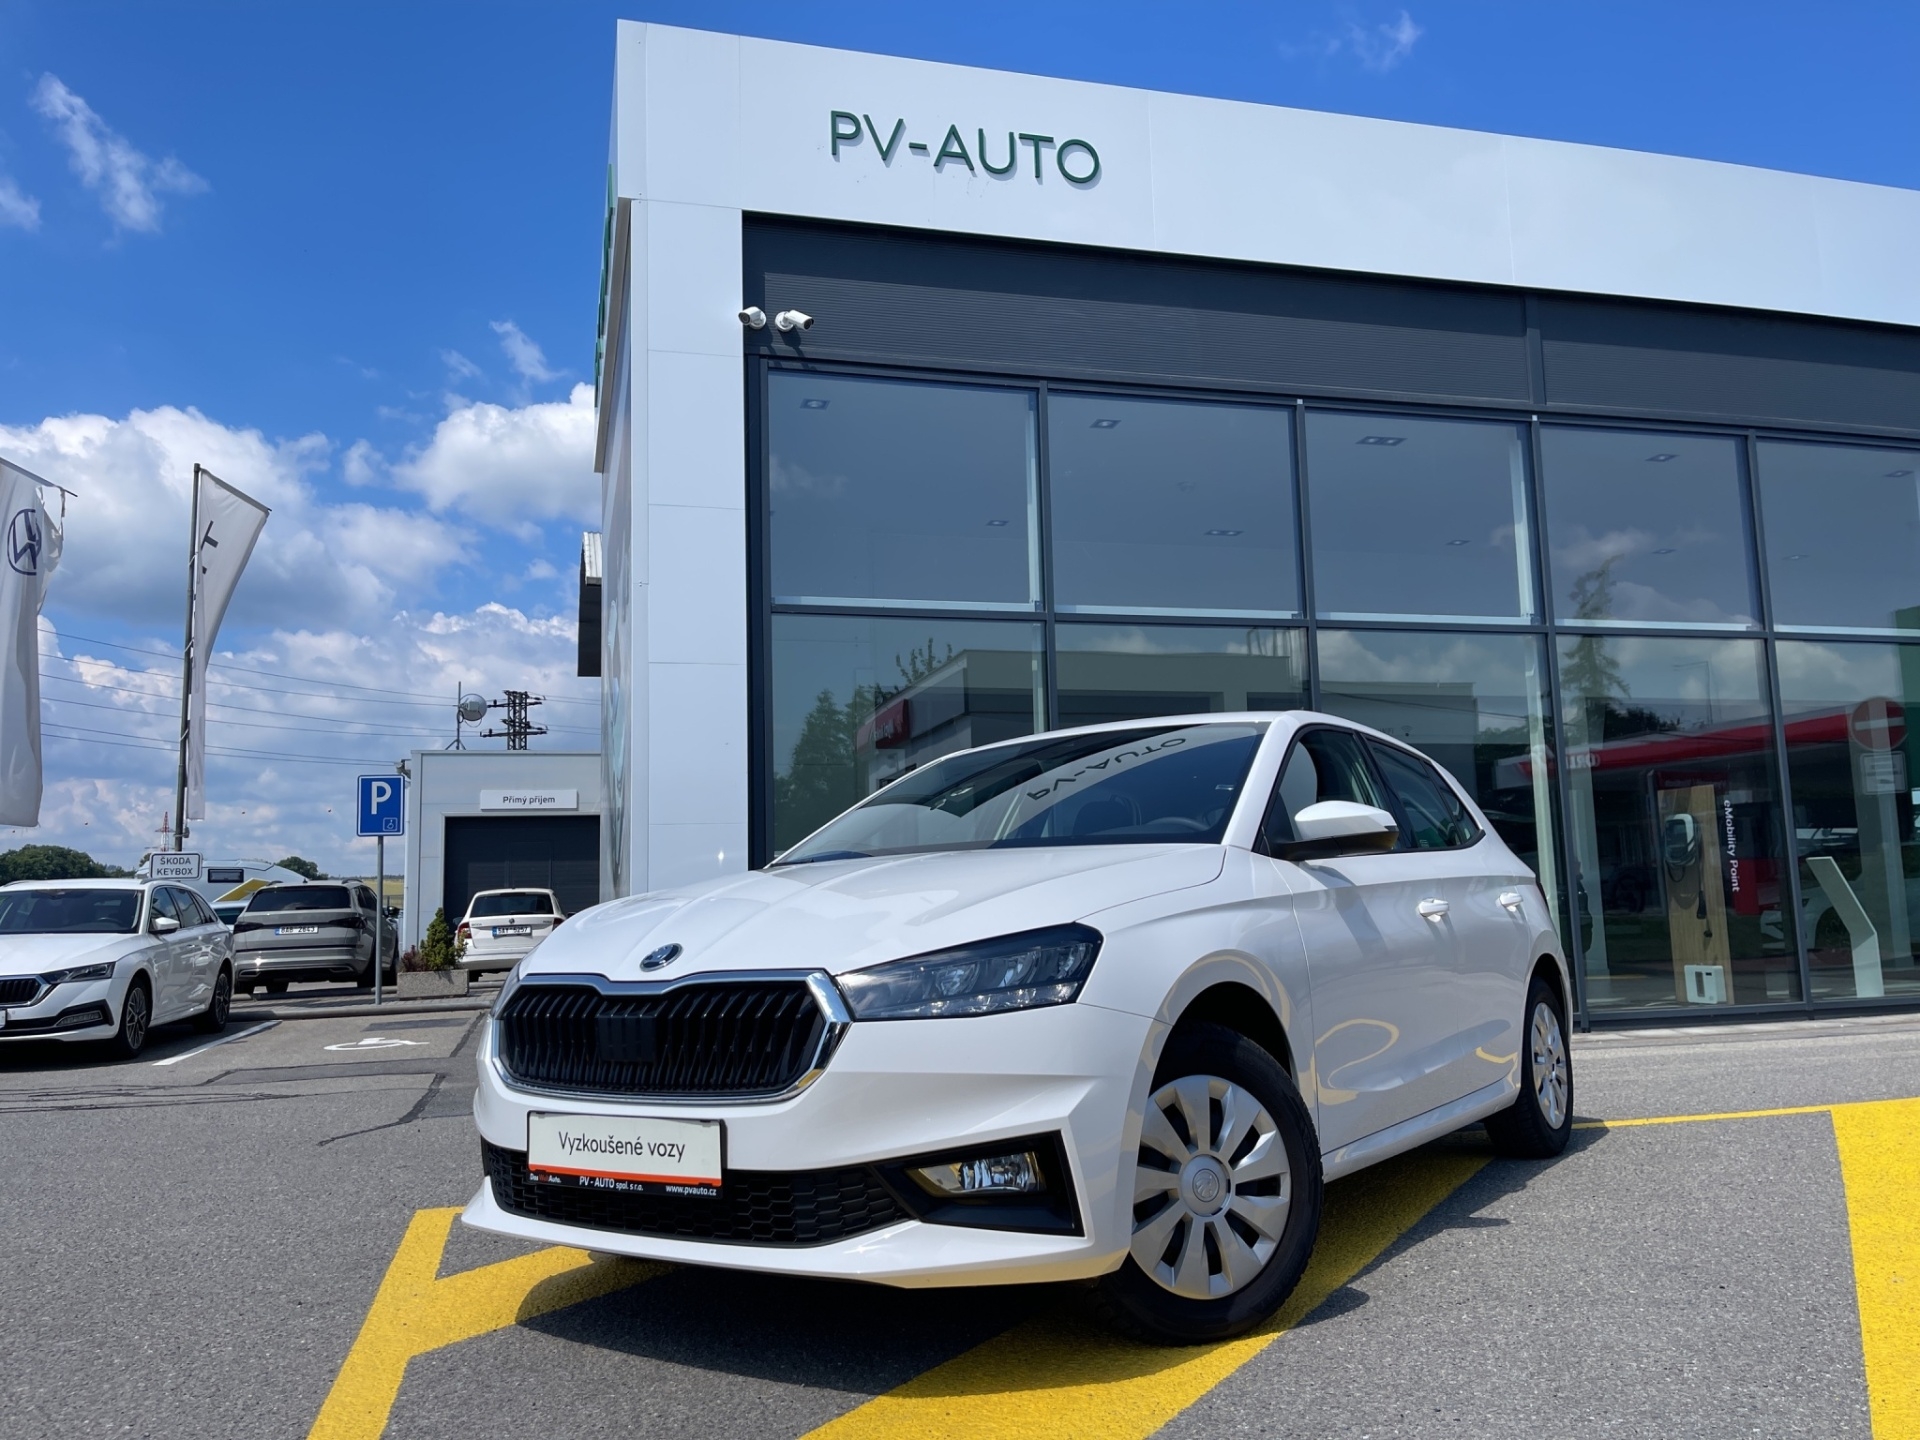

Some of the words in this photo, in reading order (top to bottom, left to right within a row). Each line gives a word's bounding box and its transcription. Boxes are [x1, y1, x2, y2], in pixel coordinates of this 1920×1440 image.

[830, 110, 1100, 184] PV-AUTO
[371, 781, 392, 815] P
[1724, 799, 1737, 856] eMobility
[156, 867, 194, 876] KEYBOX
[160, 856, 192, 865] ŠKODA
[1730, 860, 1740, 892] Point
[558, 1131, 643, 1156] Vyzkoušené
[647, 1141, 686, 1163] vozy
[579, 1176, 590, 1186] PV
[594, 1177, 615, 1189] AUTO
[615, 1181, 629, 1190] spol.
[665, 1185, 717, 1196] www.pvauto.cz
